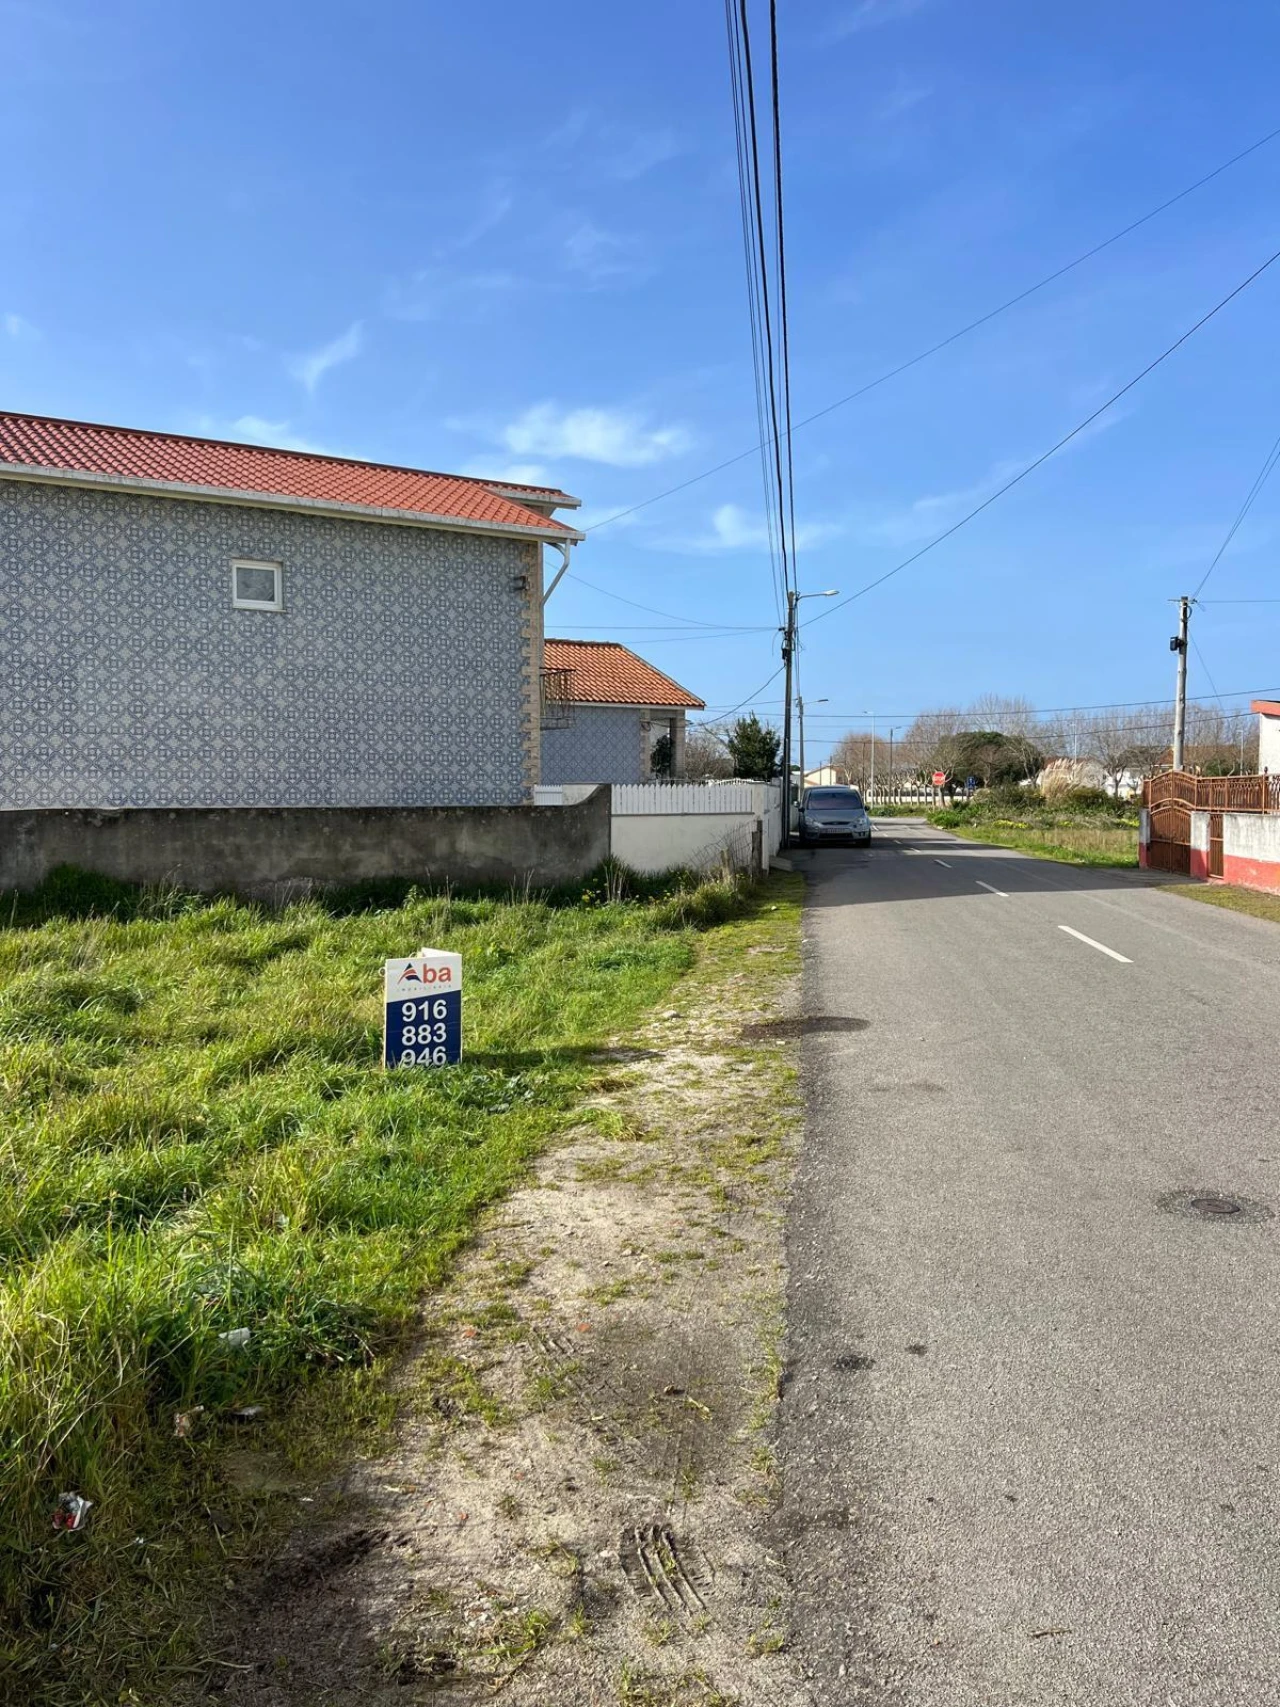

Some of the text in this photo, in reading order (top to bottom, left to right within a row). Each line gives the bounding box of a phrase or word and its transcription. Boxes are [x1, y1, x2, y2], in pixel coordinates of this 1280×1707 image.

[401, 1000, 448, 1022] 916
[401, 1022, 447, 1046] 883
[400, 1046, 447, 1068] 946
